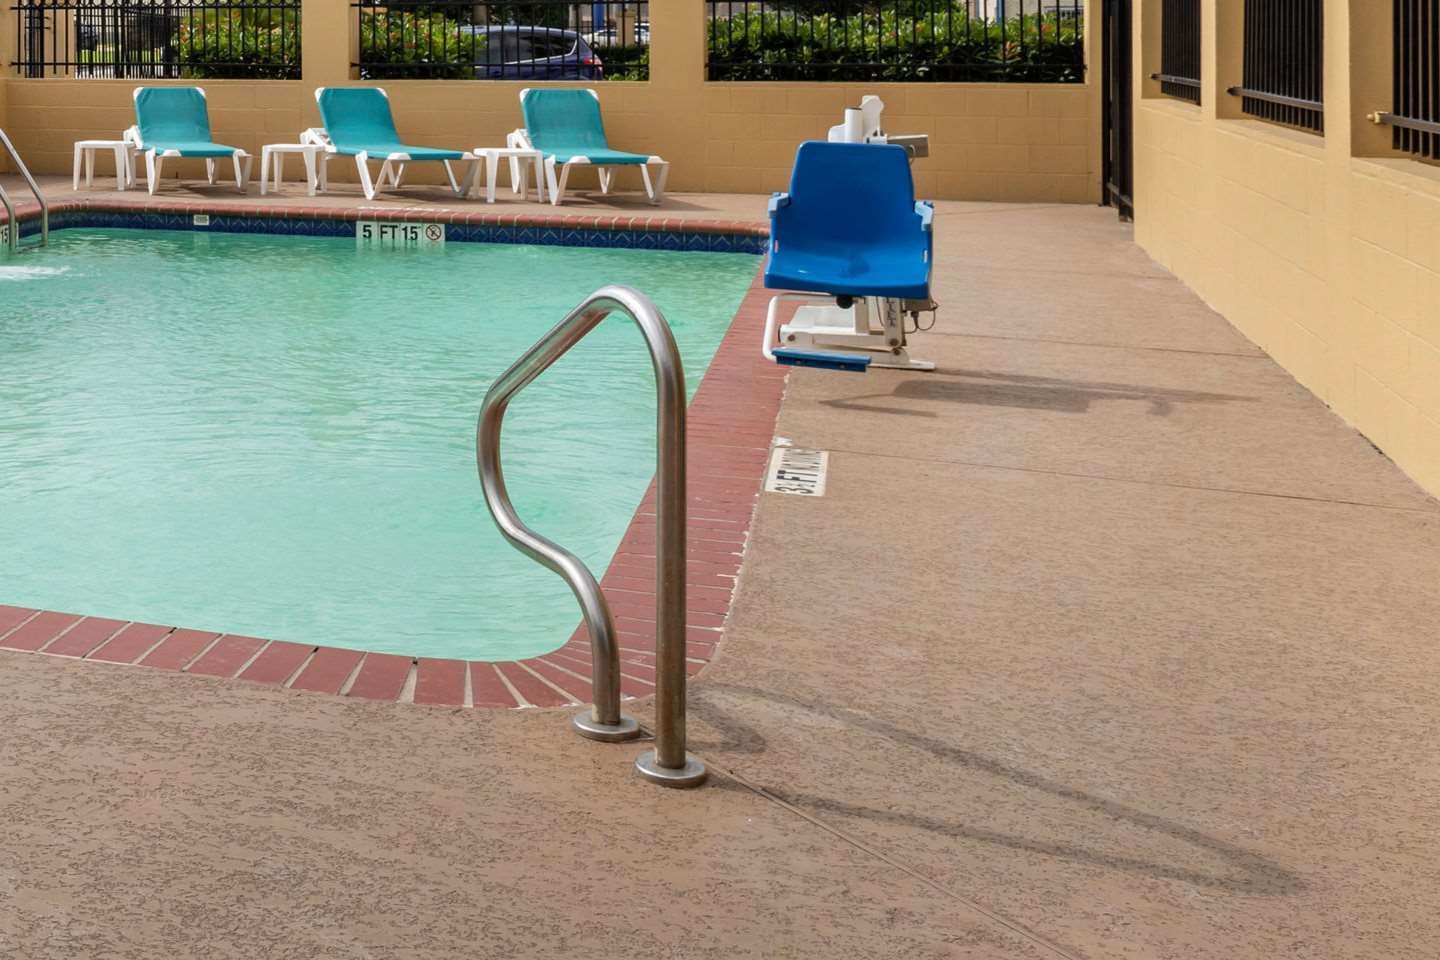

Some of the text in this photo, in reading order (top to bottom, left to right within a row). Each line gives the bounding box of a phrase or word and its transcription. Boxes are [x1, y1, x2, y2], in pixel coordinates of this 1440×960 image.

[362, 224, 373, 239] 5
[380, 224, 399, 240] FT
[776, 470, 819, 482] FT
